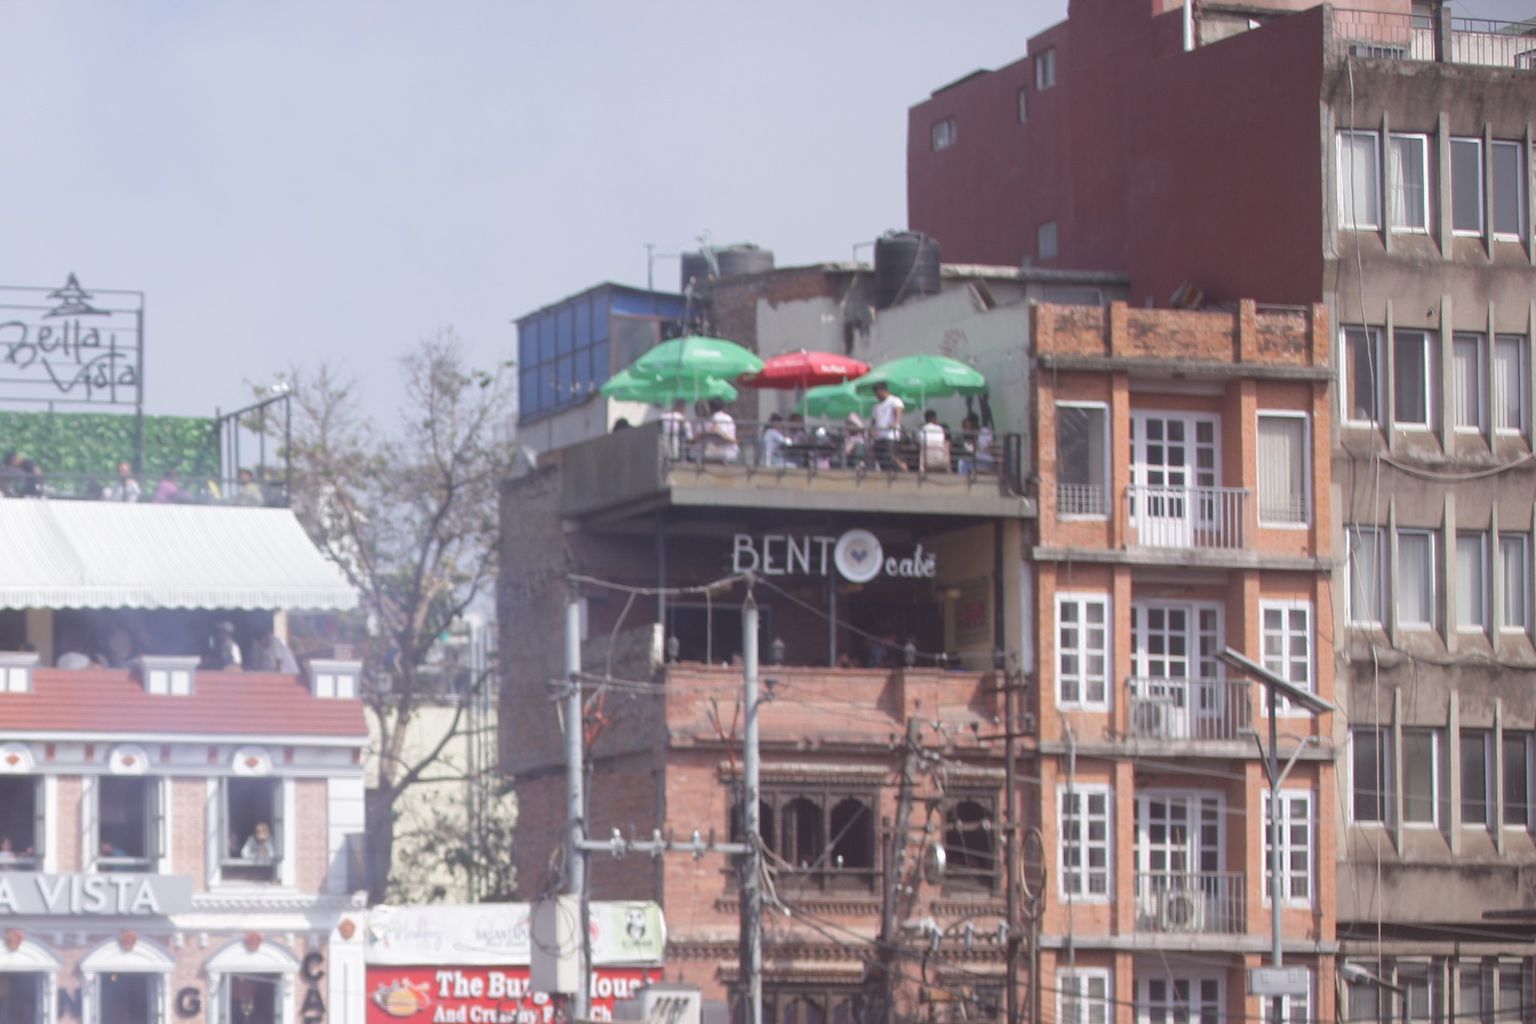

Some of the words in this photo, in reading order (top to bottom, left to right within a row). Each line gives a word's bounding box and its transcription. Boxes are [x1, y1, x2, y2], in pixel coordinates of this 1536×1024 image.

[41, 333, 137, 404] Vista
[34, 875, 162, 913] VISTA
[435, 970, 485, 999] The
[432, 1004, 466, 1024] And
